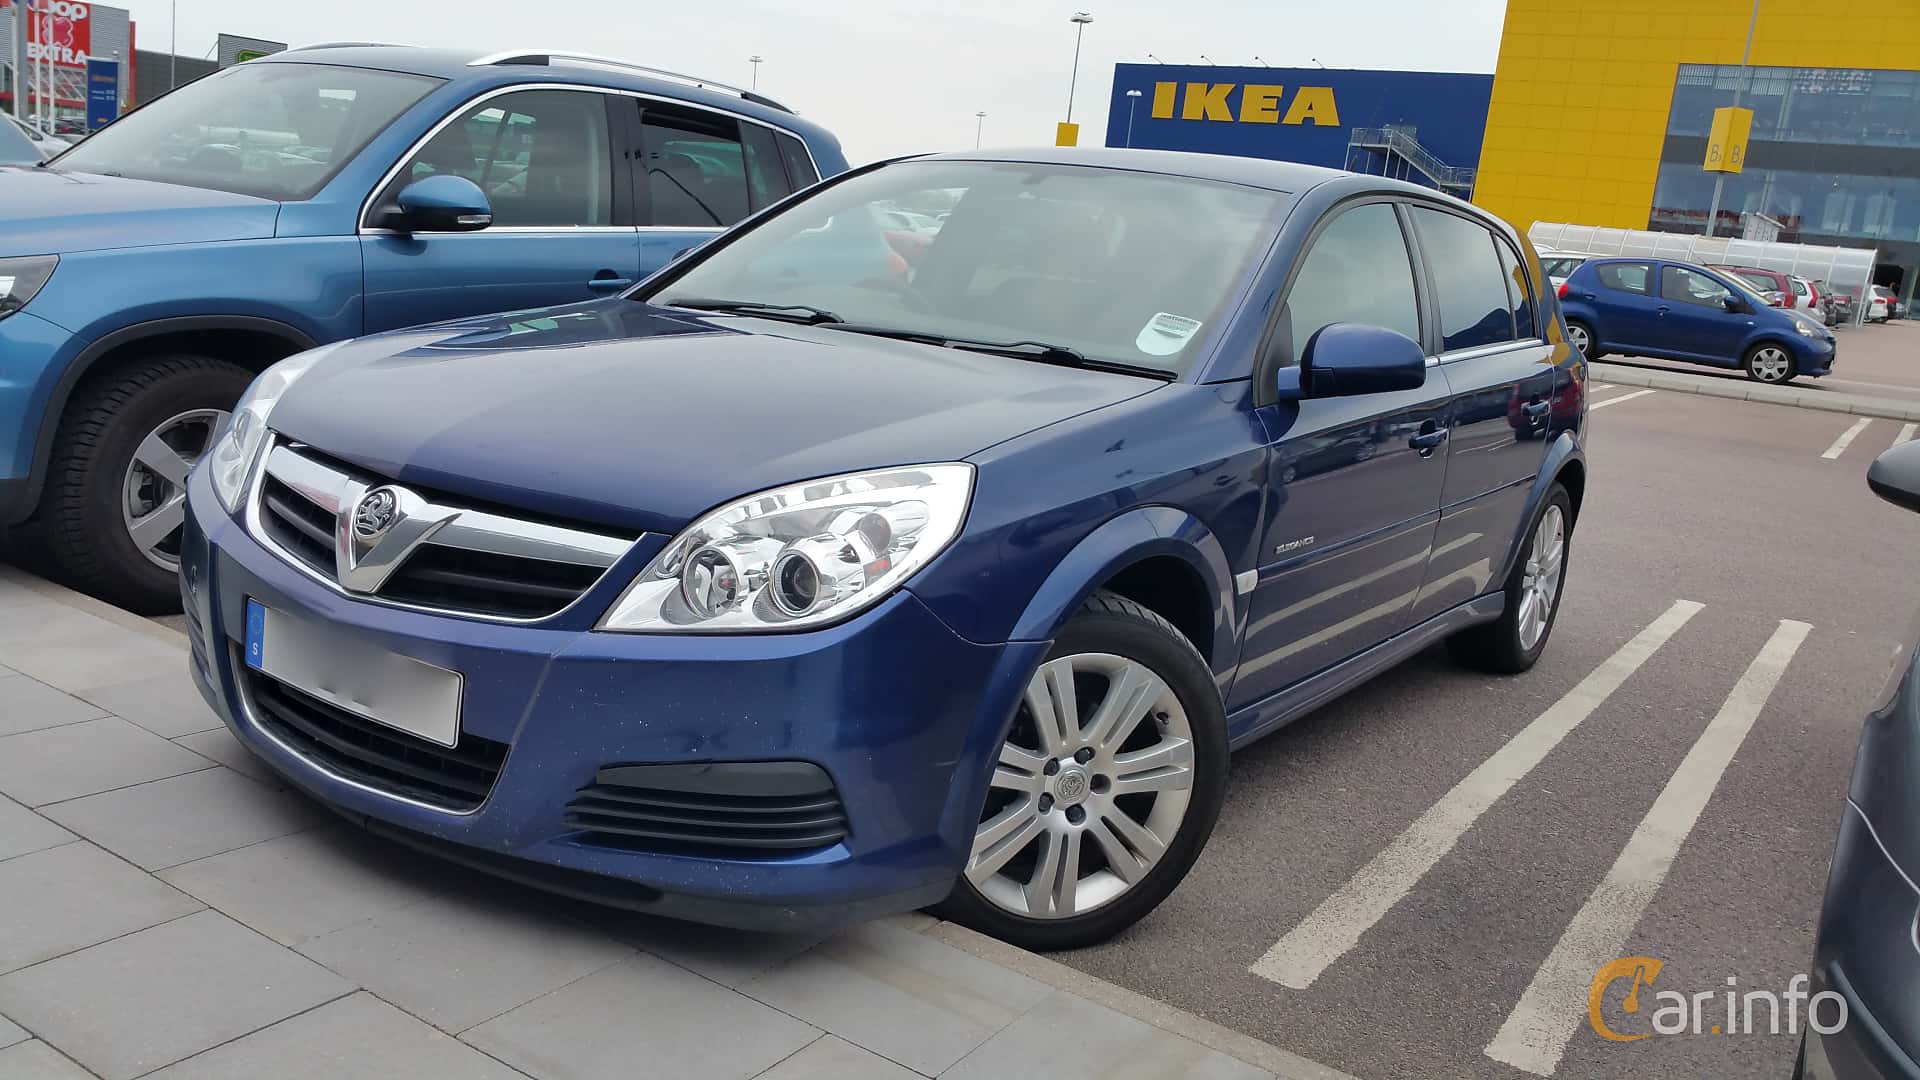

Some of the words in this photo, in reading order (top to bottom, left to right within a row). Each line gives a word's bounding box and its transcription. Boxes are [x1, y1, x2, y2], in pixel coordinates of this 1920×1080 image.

[27, 42, 87, 65] EXTRA
[1151, 81, 1341, 127] IKEA
[252, 642, 259, 656] S
